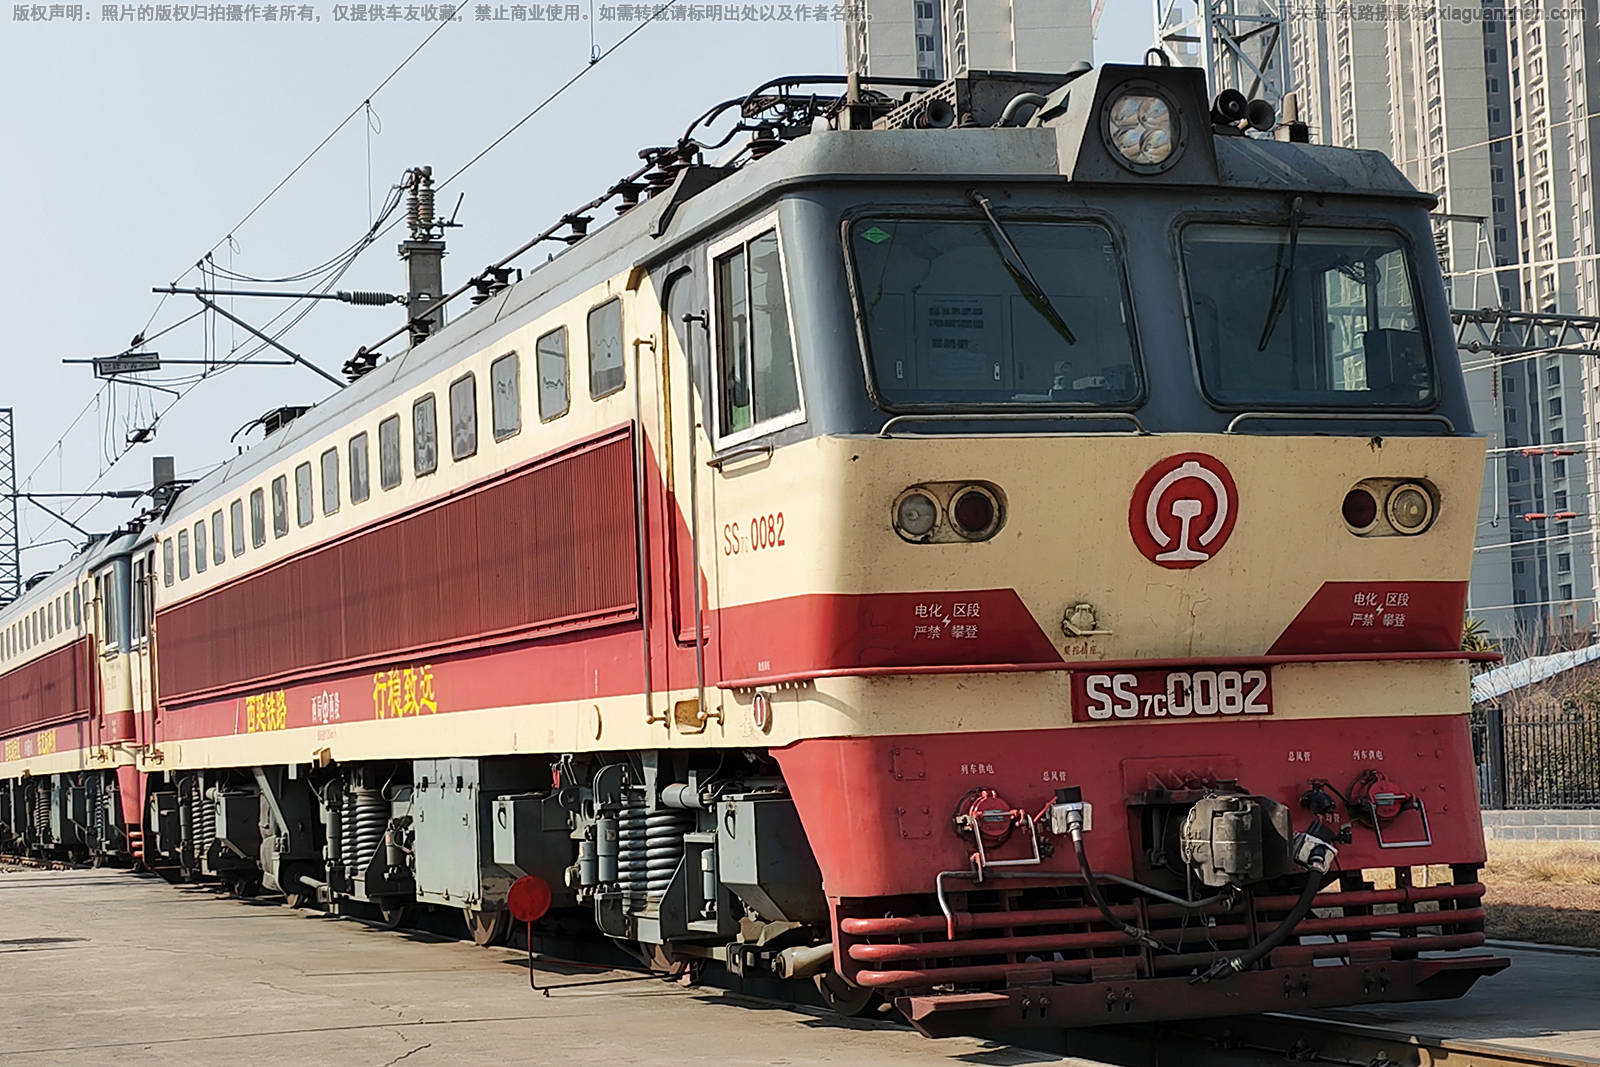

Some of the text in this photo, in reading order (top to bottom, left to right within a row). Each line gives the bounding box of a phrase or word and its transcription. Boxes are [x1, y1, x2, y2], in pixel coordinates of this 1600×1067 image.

[1354, 591, 1410, 607] 电化 区段
[915, 603, 981, 618] 电化 区段
[1350, 612, 1406, 628] 严禁 攀登
[913, 625, 979, 640] 严禁 攀登
[373, 664, 437, 720] 行稳致远
[1287, 749, 1384, 763] 总风管 列车供电
[961, 763, 995, 775] 列车供电
[1042, 771, 1067, 782] 总风管
